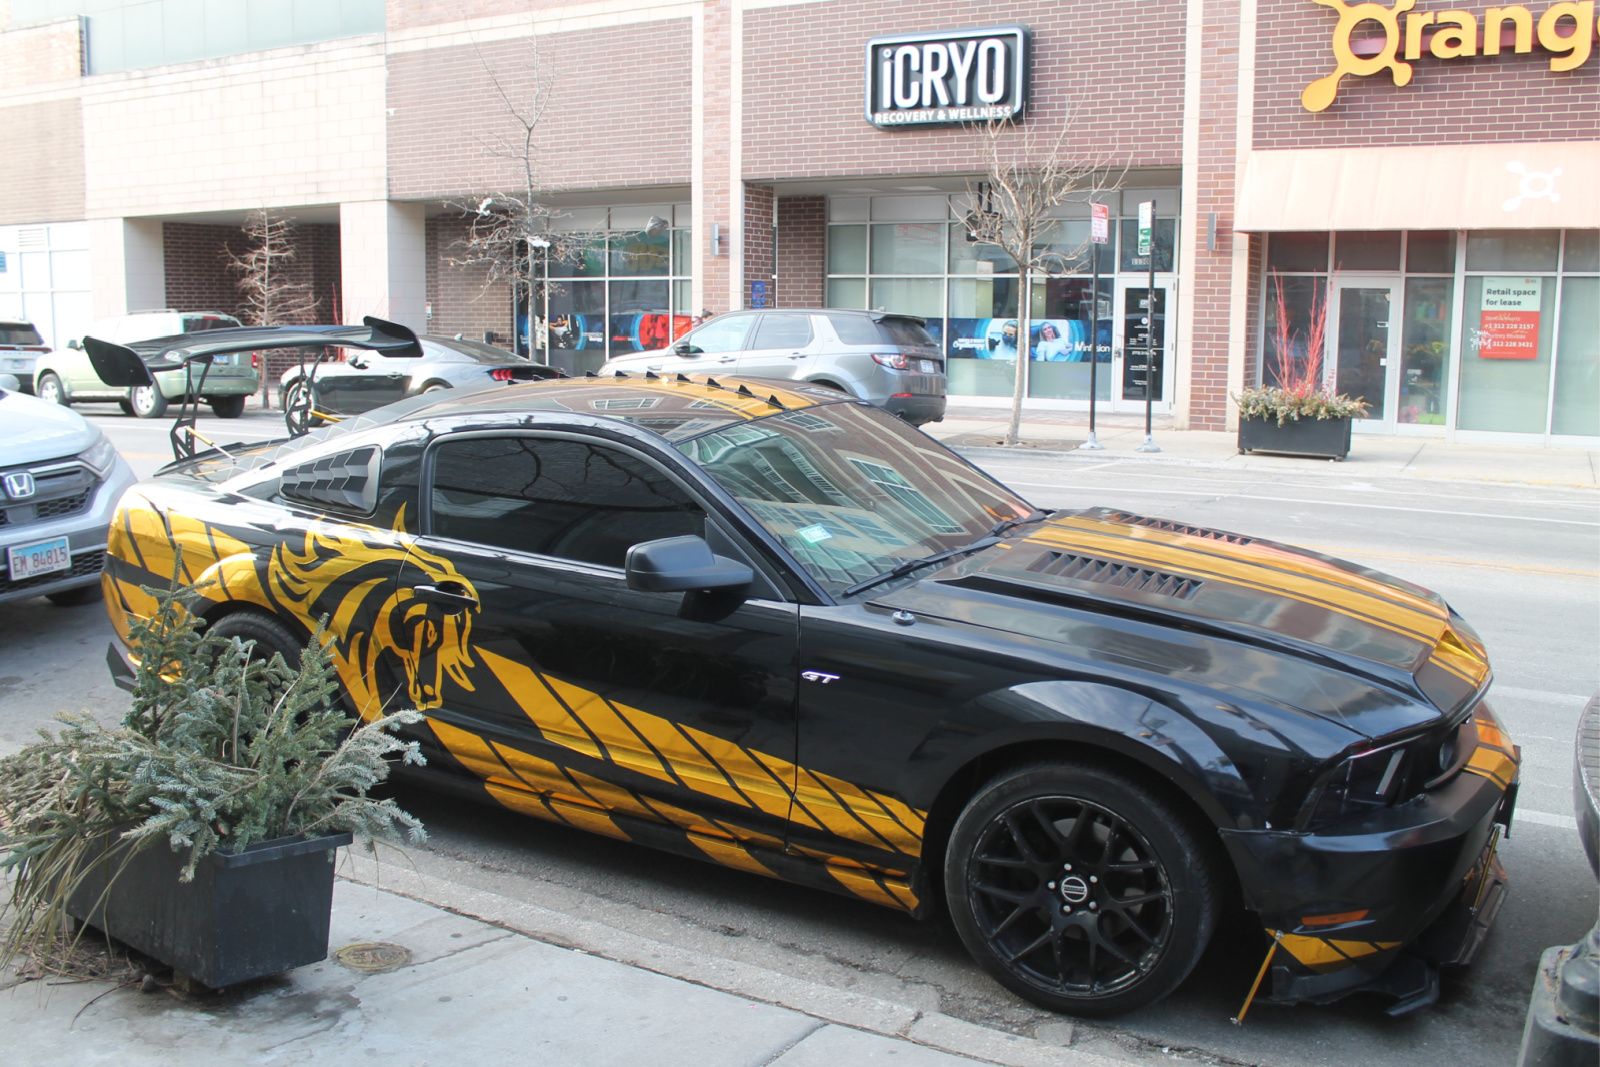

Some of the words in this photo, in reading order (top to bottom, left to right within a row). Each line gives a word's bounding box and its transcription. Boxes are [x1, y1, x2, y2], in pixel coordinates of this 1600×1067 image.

[1303, 0, 1600, 103] Orang
[882, 38, 1005, 109] iCRYO
[874, 110, 935, 124] RECOVERY
[937, 109, 946, 120] &
[947, 106, 1012, 120] WELLNESS
[1486, 288, 1511, 296] Retail
[1513, 289, 1537, 297] space
[32, 546, 68, 568] 84815
[802, 671, 840, 684] GT
